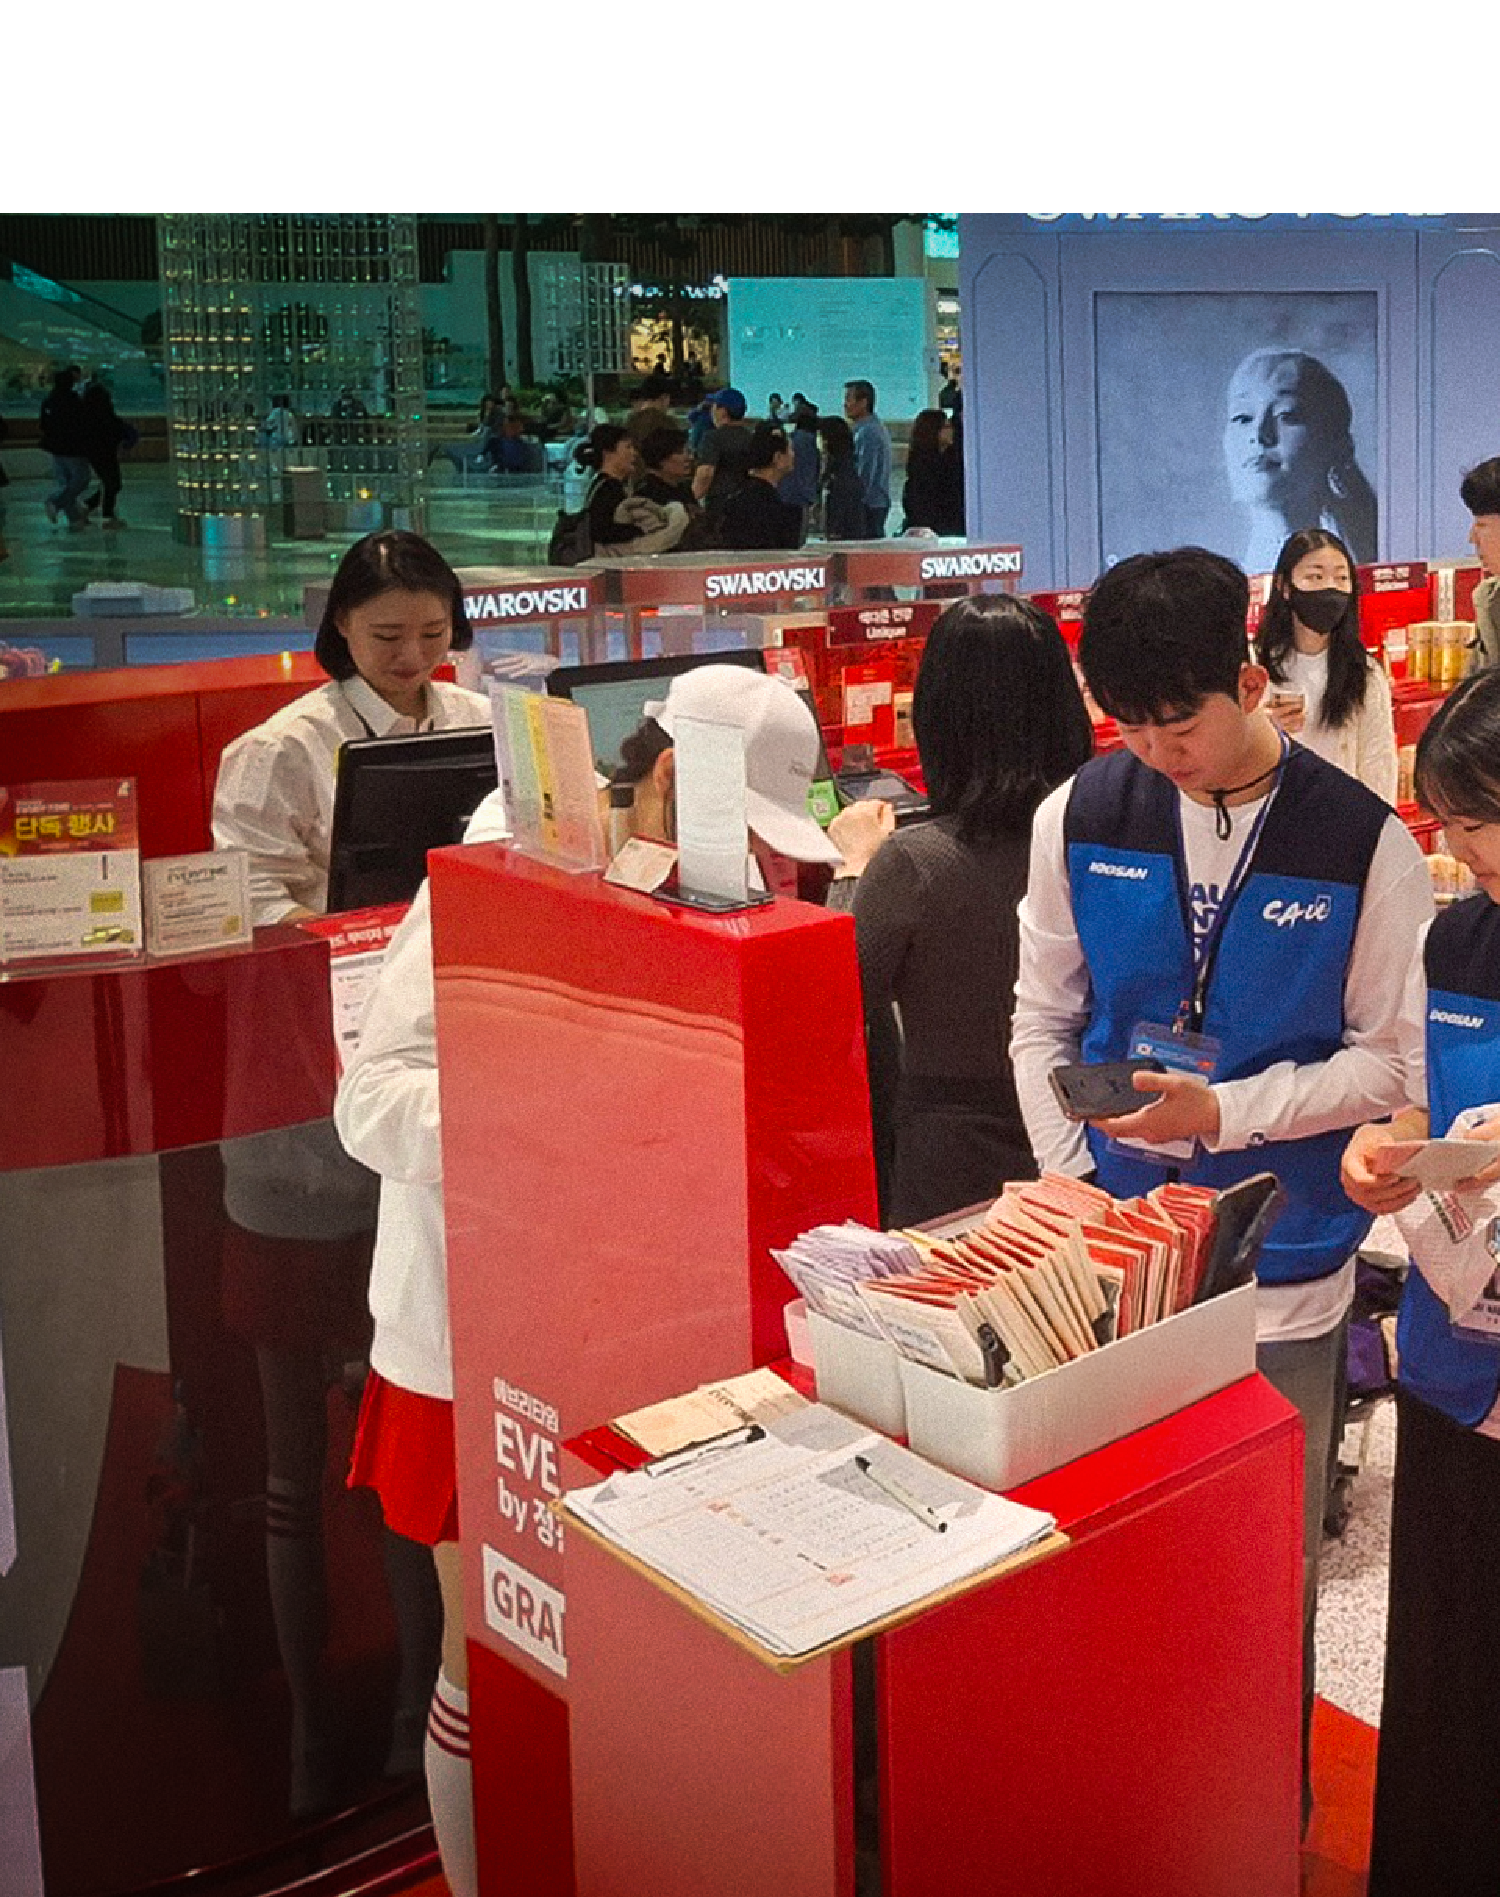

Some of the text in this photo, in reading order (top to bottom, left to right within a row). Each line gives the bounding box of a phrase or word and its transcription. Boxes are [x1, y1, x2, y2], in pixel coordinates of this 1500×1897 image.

[705, 568, 826, 597] SWAROVSKI
[921, 552, 1021, 580] SWAROVSKI
[493, 1375, 559, 1434] 에브리타임
[496, 1474, 528, 1533] by
[490, 1569, 564, 1657] GRA
